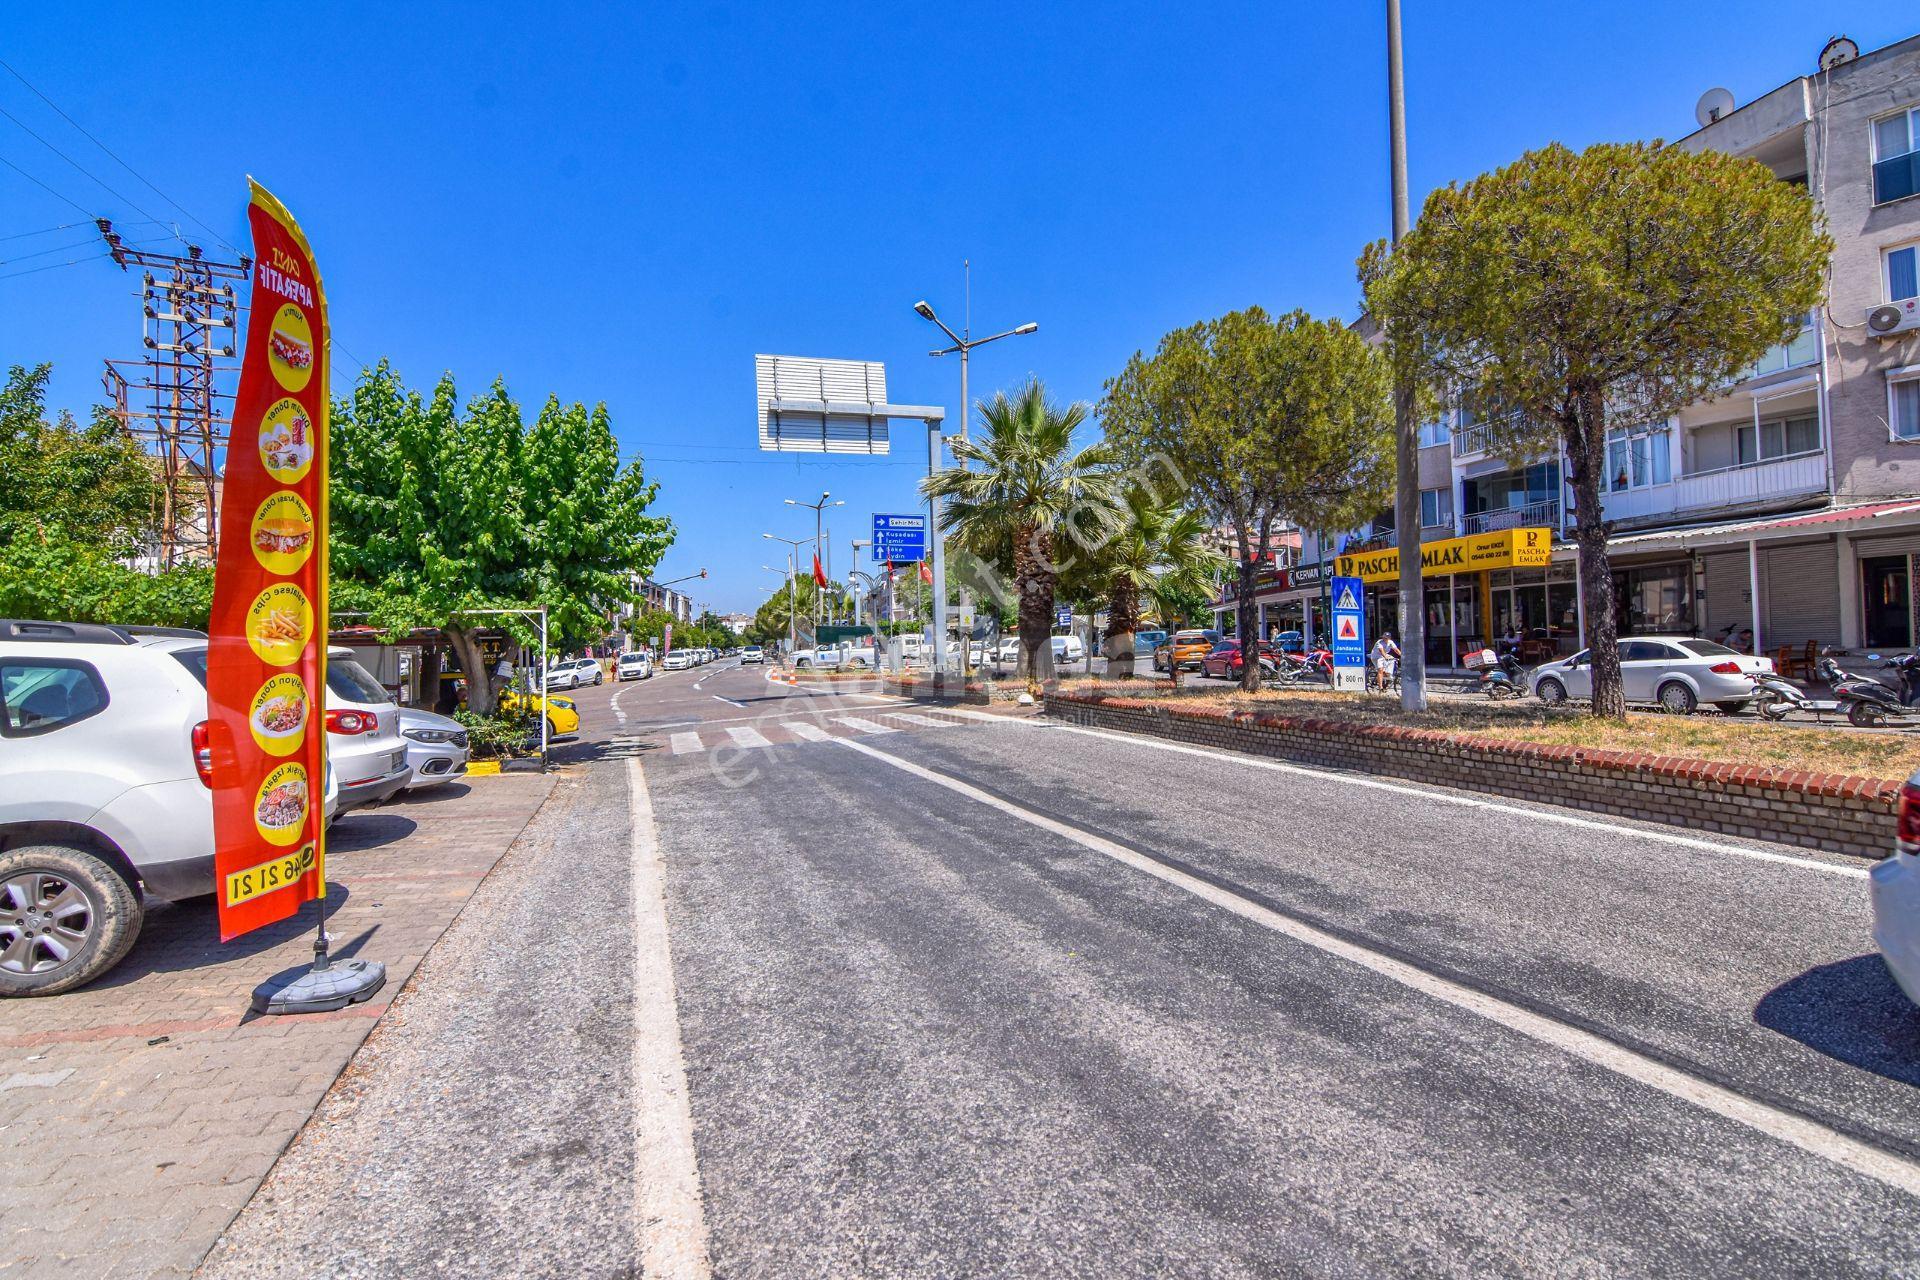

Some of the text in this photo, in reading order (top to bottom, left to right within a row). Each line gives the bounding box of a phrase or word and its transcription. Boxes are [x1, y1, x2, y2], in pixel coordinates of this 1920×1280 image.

[890, 519, 908, 527] Şehir
[1358, 555, 1400, 576] PASCH
[1421, 546, 1464, 568] MLAK
[1295, 567, 1319, 580] KERVAN
[1345, 675, 1356, 683] 800
